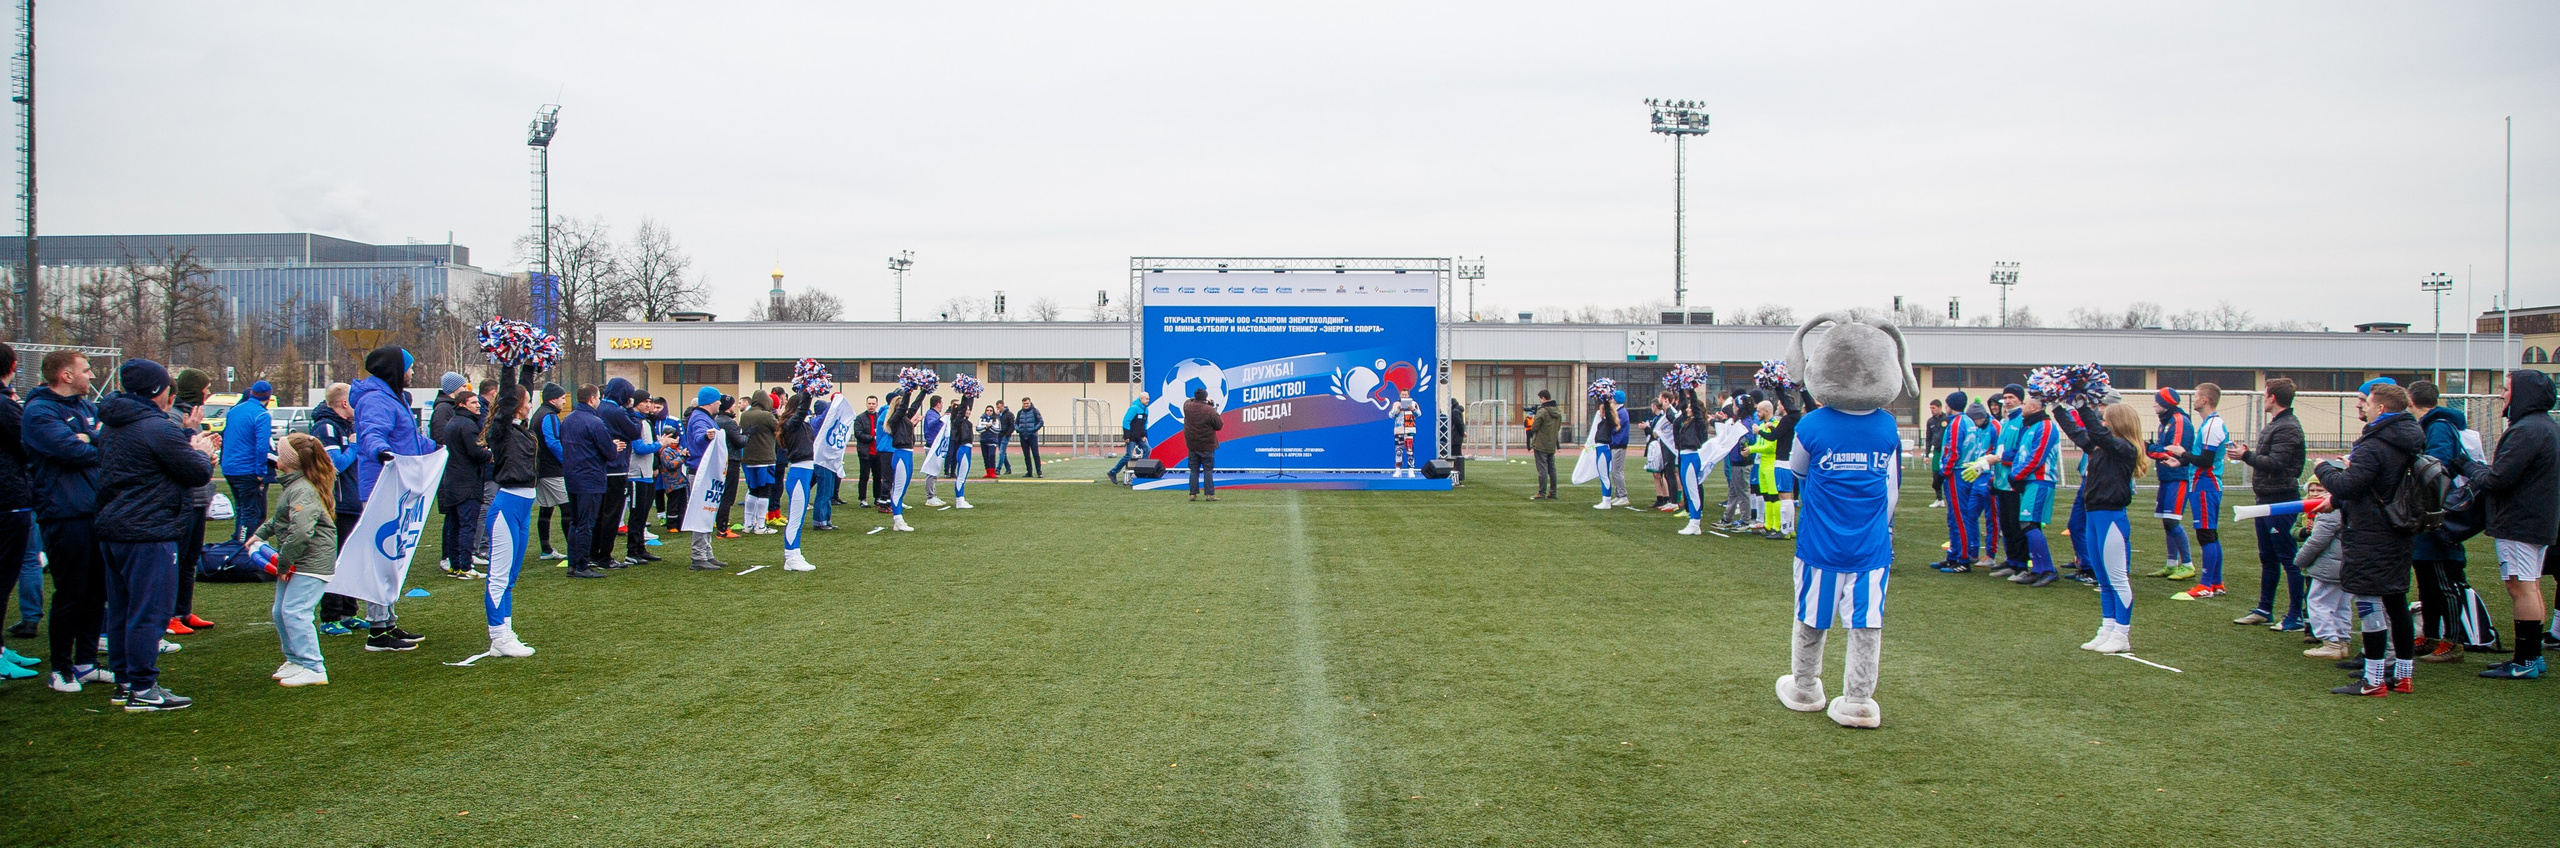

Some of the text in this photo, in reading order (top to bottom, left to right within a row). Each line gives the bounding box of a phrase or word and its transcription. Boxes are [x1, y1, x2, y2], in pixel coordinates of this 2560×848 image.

[1164, 316, 1349, 325] ОТКРЫТЫЕ ТУРНИРЫ ООО «ГАЗПРОМ ЭНЕРГОХОЛДИНГ»
[1164, 325, 1385, 333] ПО МИНИ-ФУТБОЛУ И НАСТОЛЬНОМУ ТЕННИСУ «ЭНЕРГИЯ СПОРТА»
[609, 337, 652, 349] КАФЕ
[1242, 361, 1294, 383] ДРУЖБА!
[1243, 380, 1306, 403] ЕДИНСТВО!
[1243, 402, 1292, 423] ПОБЕДА!
[1833, 452, 1867, 462] ГАЗПРОМ
